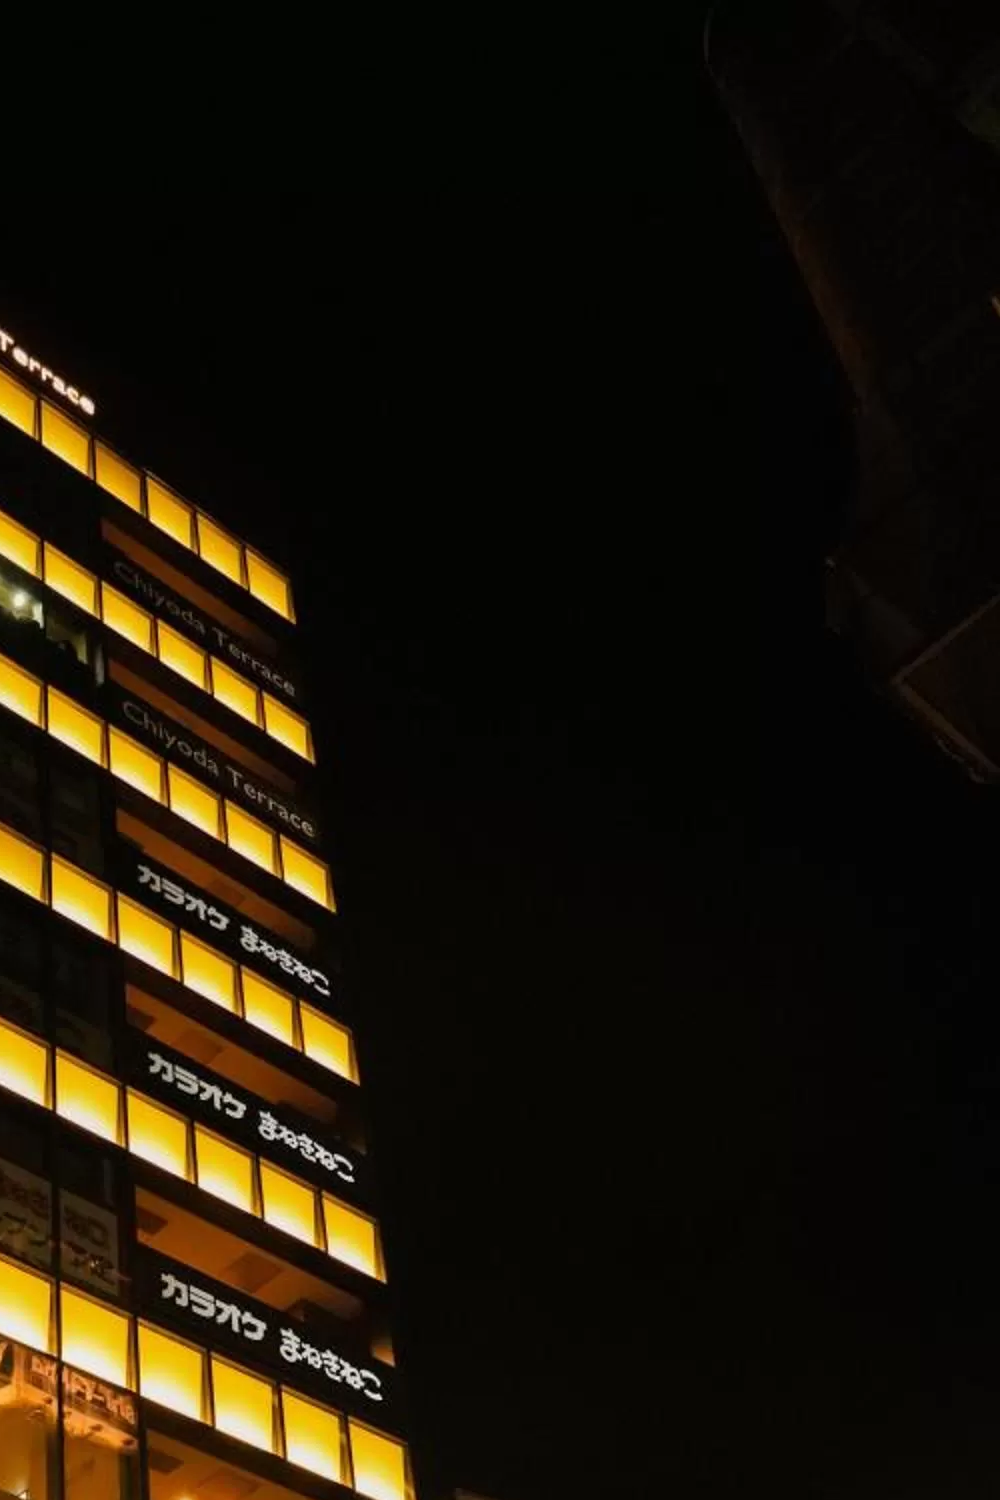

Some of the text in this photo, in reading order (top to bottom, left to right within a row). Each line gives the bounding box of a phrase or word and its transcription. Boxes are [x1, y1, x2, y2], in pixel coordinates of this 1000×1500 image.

[114, 560, 297, 697] Chiyoda Terrace
[122, 700, 317, 837] Chiyoda Terrace
[137, 864, 331, 996] カラオケ まねきねこ
[148, 1050, 355, 1183] カラオケ まねきねこ
[160, 1272, 383, 1401] カラオケ まねきねこ
